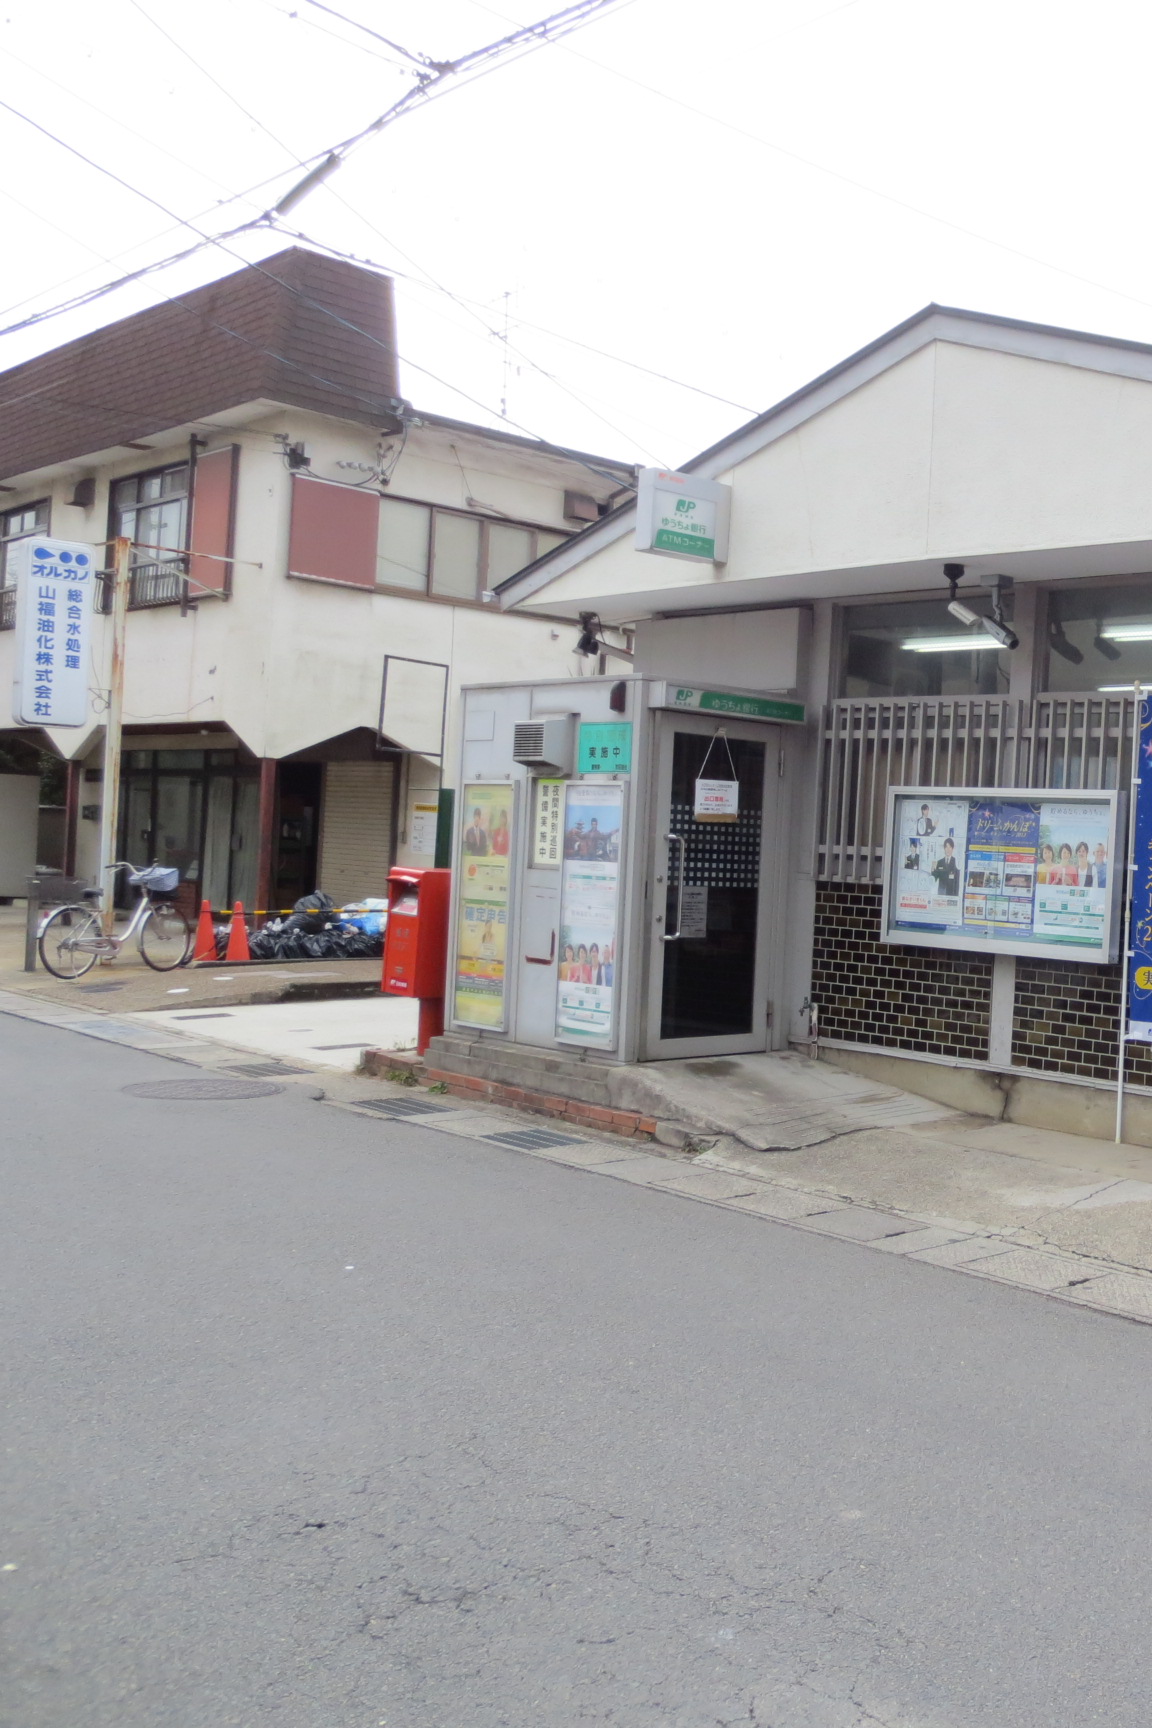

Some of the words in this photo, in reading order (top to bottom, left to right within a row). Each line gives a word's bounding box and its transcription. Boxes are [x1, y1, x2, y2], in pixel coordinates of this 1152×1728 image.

[33, 585, 56, 717] 山福油化株式会社
[64, 588, 83, 669] 総合水処理
